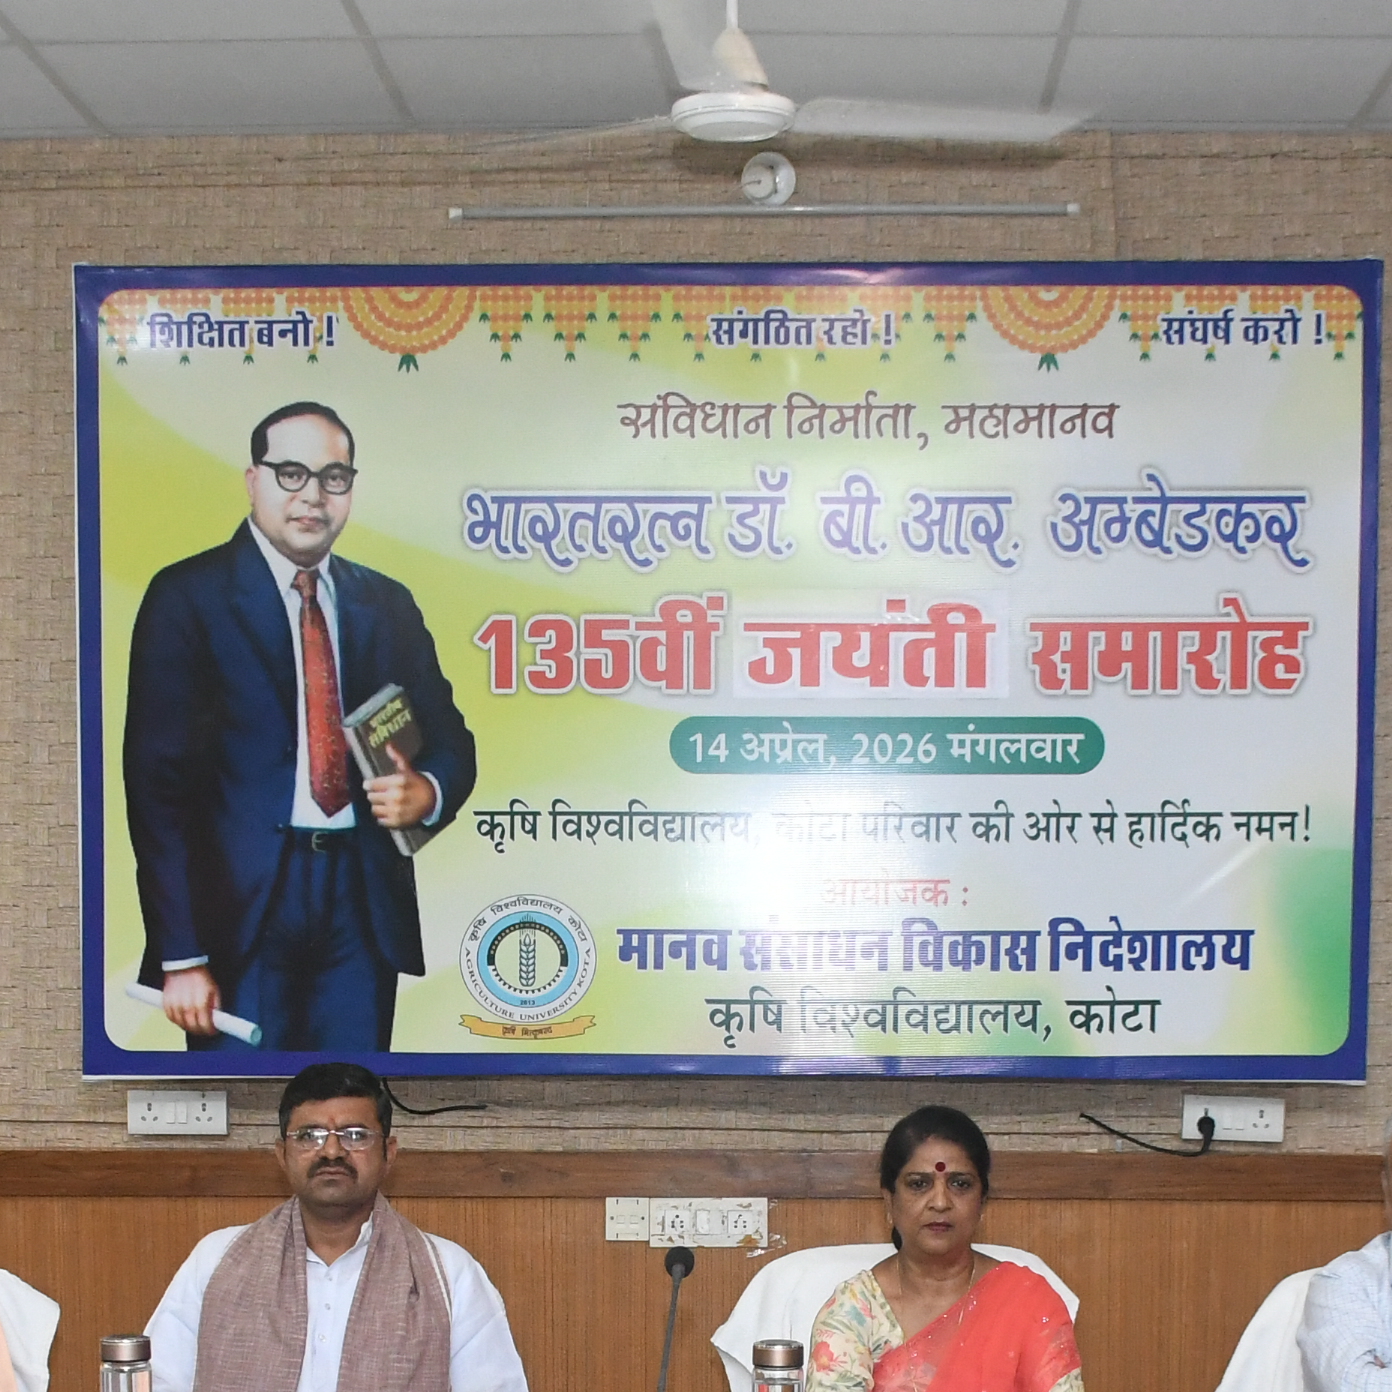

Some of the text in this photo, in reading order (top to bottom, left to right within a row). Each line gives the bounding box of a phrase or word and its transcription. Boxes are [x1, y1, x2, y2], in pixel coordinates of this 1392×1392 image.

[149, 310, 249, 348] शिक्षित
[255, 310, 314, 348] बनो
[711, 308, 814, 347] संगठित
[821, 308, 872, 347] रहो
[1161, 308, 1234, 346] संघर्ष
[1241, 308, 1300, 346] करो
[616, 390, 1120, 450] संविधान निर्माता, महामानव
[465, 493, 712, 570] भारतरत्न
[726, 470, 794, 555] डॉ.
[1050, 474, 1310, 568] अम्बेडकर
[477, 595, 1310, 692] 135वीं जयंती समारोह
[691, 734, 729, 763] 14
[852, 732, 936, 764] 2026
[946, 723, 1084, 765] मंगलवार
[474, 799, 539, 853] कृषि
[858, 801, 961, 844] परिवार
[969, 799, 1013, 843] की
[1022, 799, 1081, 843] ओर
[1090, 799, 1116, 843] से
[1125, 799, 1222, 846] हार्दिक
[821, 870, 950, 907] आयोजक
[616, 914, 1255, 972] मानव संसाधन विकास निदेशालय
[465, 947, 591, 1021] AGRICULTURE UNIVERSITY KOTA
[706, 986, 1161, 1048] कृषि विश्वविद्यालय, कोटा
